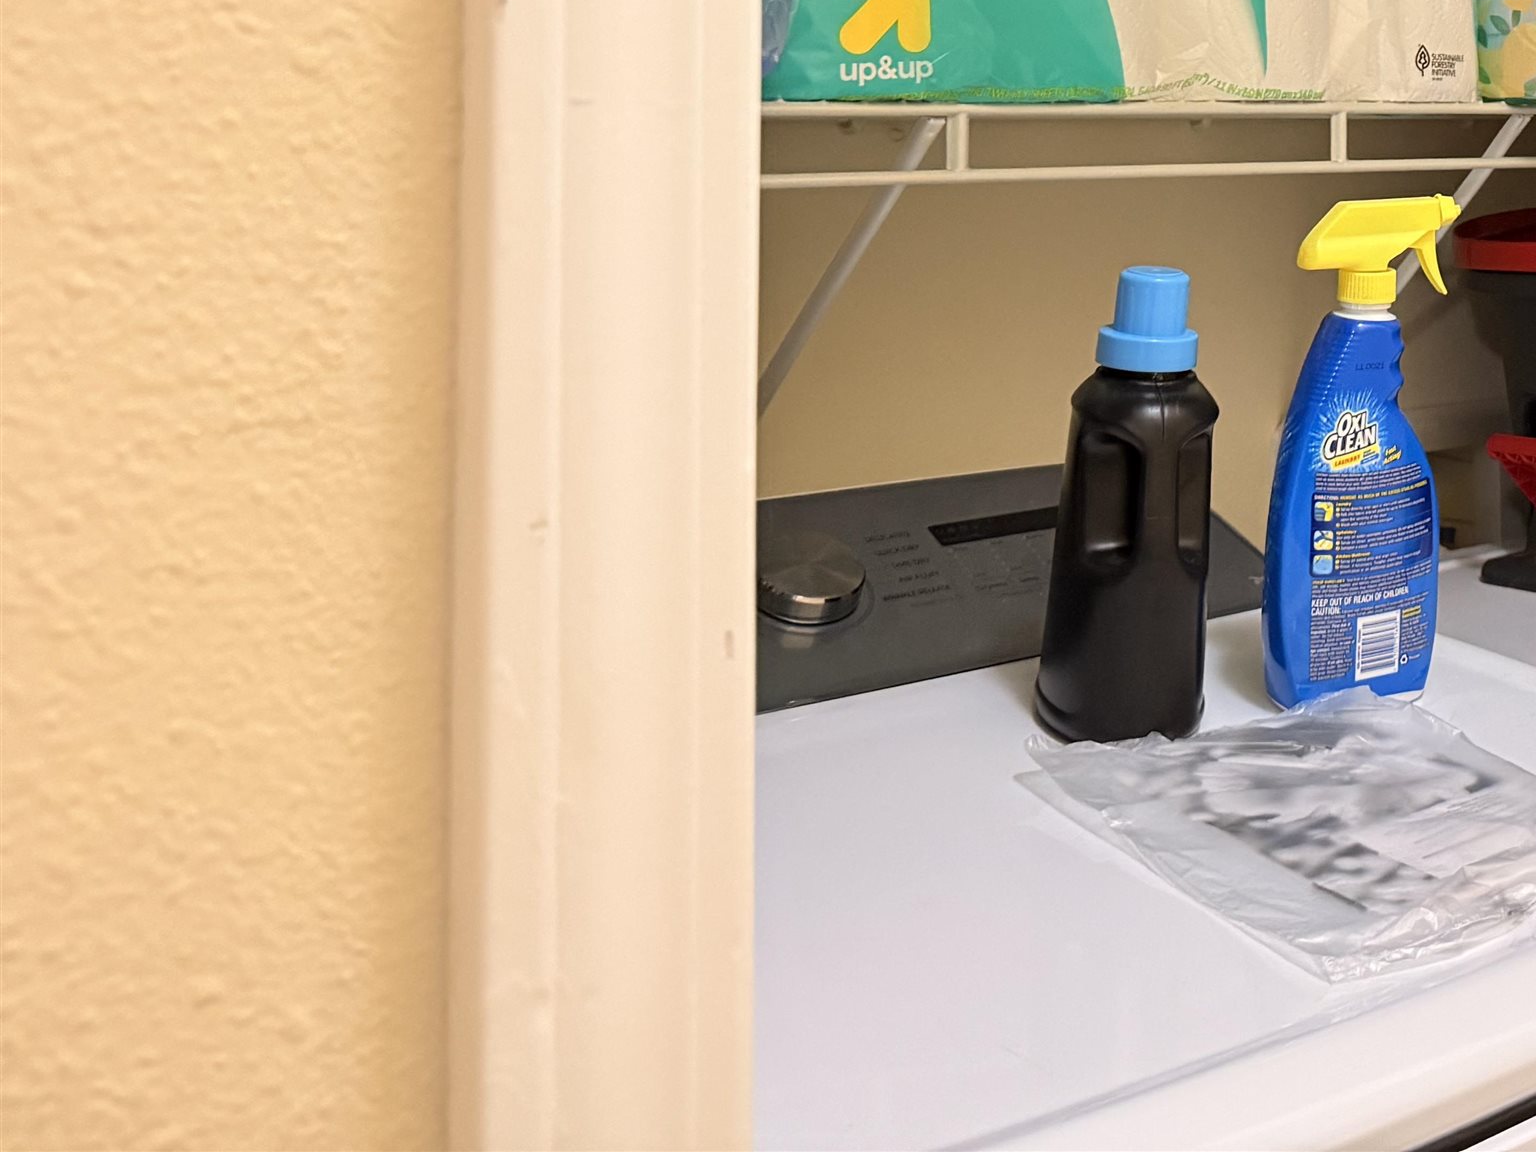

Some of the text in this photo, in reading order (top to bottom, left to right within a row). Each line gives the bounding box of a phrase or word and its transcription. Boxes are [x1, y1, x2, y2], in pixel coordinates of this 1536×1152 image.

[839, 55, 934, 87] up&up
[1336, 410, 1368, 437] OXI
[1323, 423, 1377, 461] CLEAN
[1311, 586, 1409, 608] KEEP OUT OF REACH OF CHILDREN
[1311, 607, 1340, 616] CAUTION:
